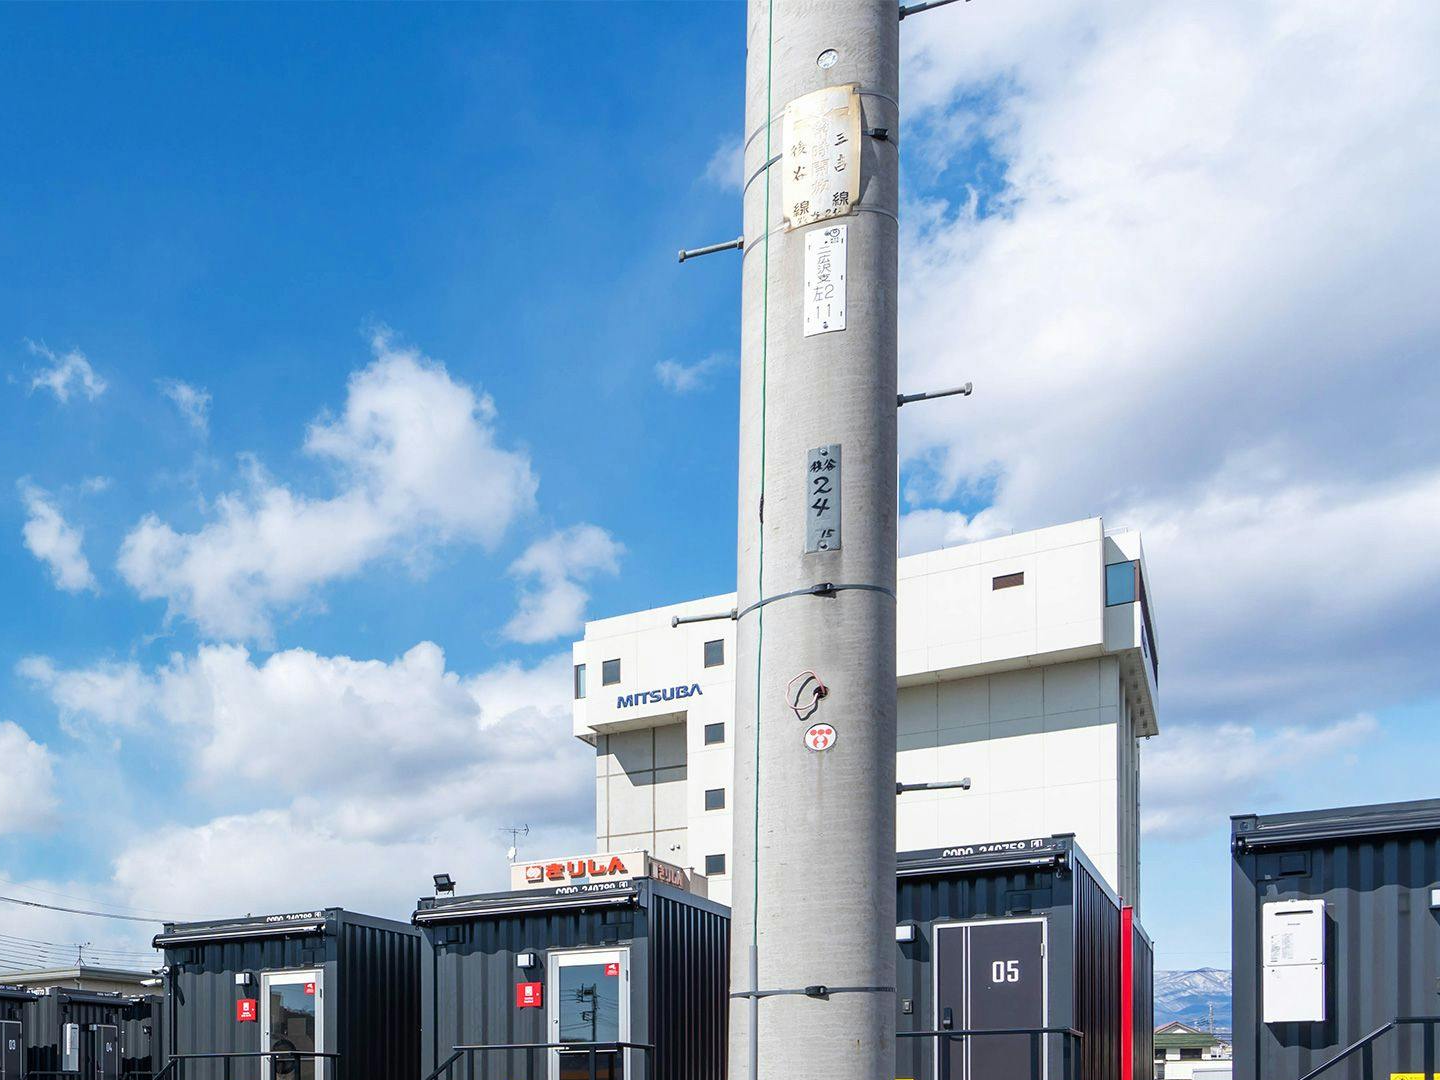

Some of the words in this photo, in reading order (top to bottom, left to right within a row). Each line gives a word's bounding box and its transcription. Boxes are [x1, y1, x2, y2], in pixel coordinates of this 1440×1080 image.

[617, 683, 703, 708] MITSUBA
[545, 856, 629, 882] きりしん
[992, 960, 1019, 982] 05
